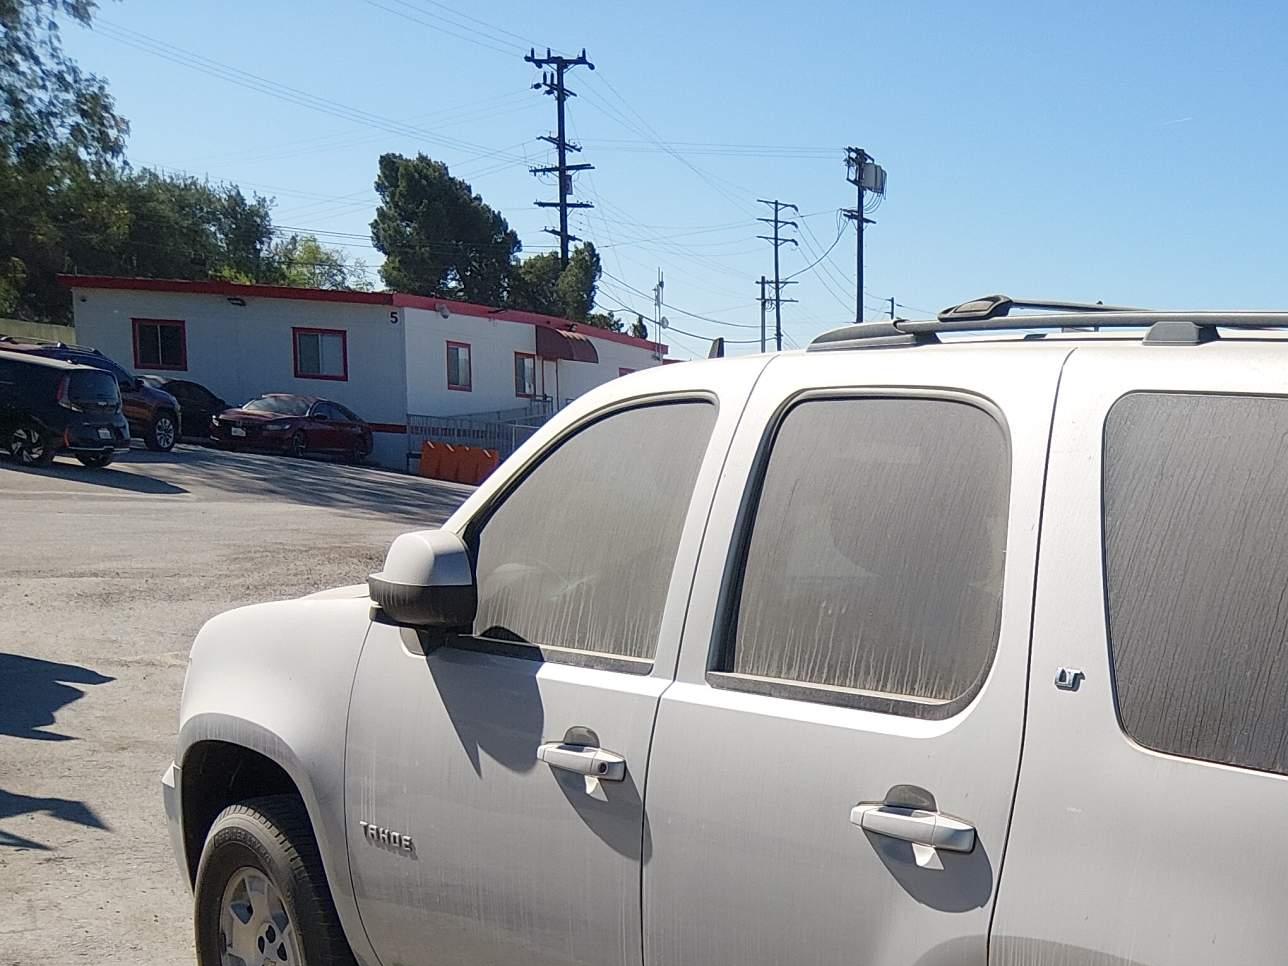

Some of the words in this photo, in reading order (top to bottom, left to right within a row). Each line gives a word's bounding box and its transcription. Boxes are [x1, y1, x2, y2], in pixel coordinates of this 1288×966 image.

[390, 311, 398, 324] 5
[1050, 661, 1085, 692] LT
[359, 820, 412, 852] TAHOE
